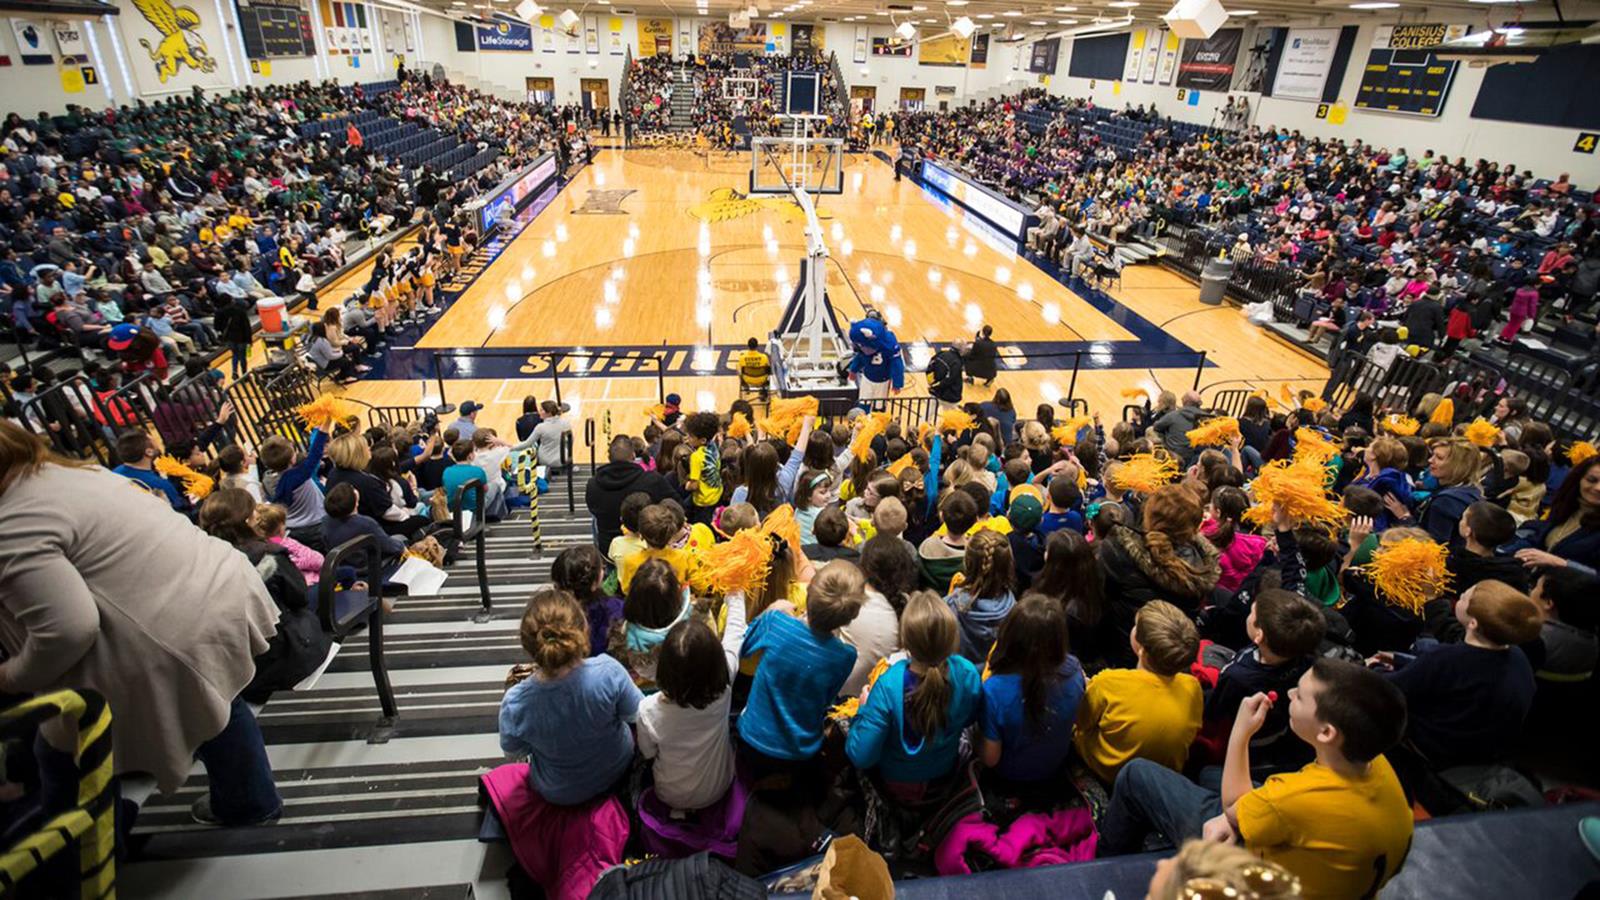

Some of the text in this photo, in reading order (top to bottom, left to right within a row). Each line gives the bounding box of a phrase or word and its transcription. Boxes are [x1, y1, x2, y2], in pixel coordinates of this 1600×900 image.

[1392, 25, 1446, 37] CANISIUS
[1391, 37, 1441, 49] COLLEGE
[84, 69, 94, 83] 7
[1318, 105, 1328, 117] 3
[1577, 135, 1595, 151] 4
